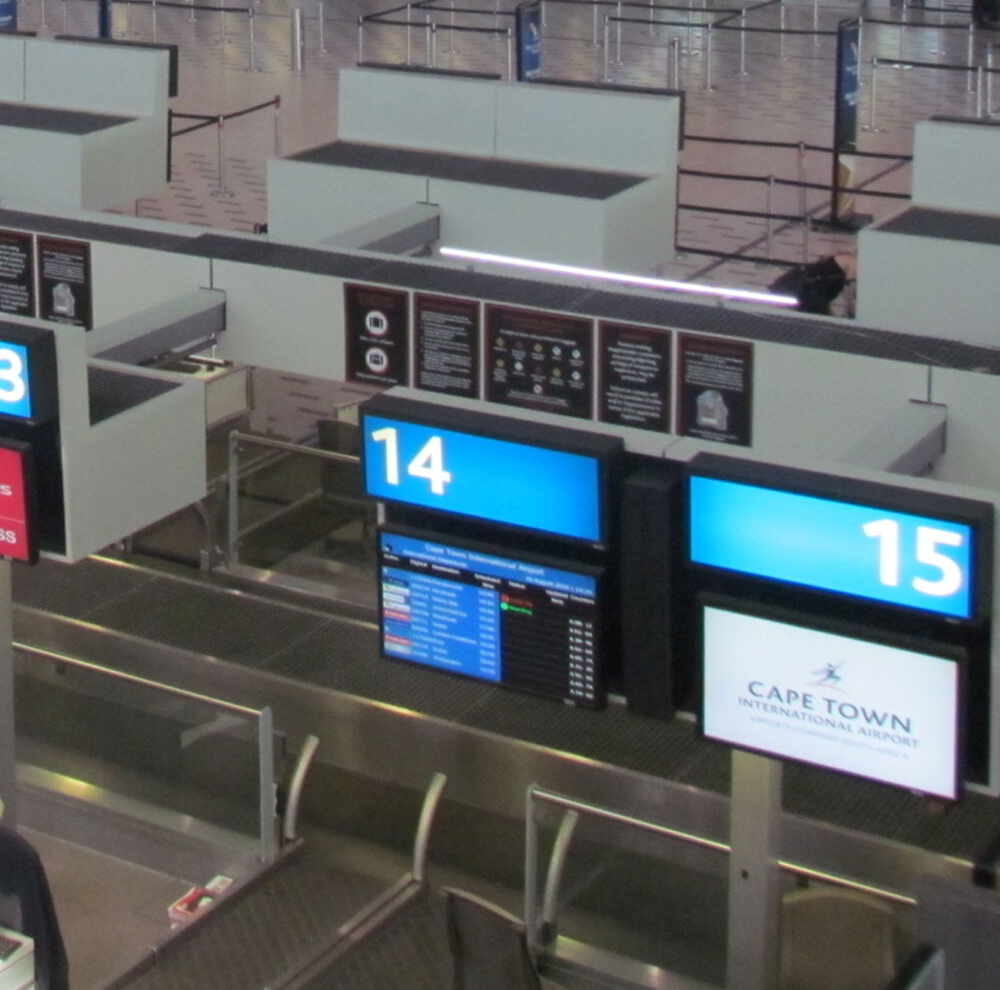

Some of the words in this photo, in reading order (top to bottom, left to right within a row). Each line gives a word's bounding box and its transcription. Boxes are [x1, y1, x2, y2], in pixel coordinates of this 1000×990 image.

[370, 426, 452, 496] 14
[862, 518, 965, 597] 15
[738, 697, 854, 733] INTERNATIONAL
[857, 726, 920, 749] AIRPORT
[747, 680, 815, 711] CAPE
[822, 697, 912, 734] TOWN
